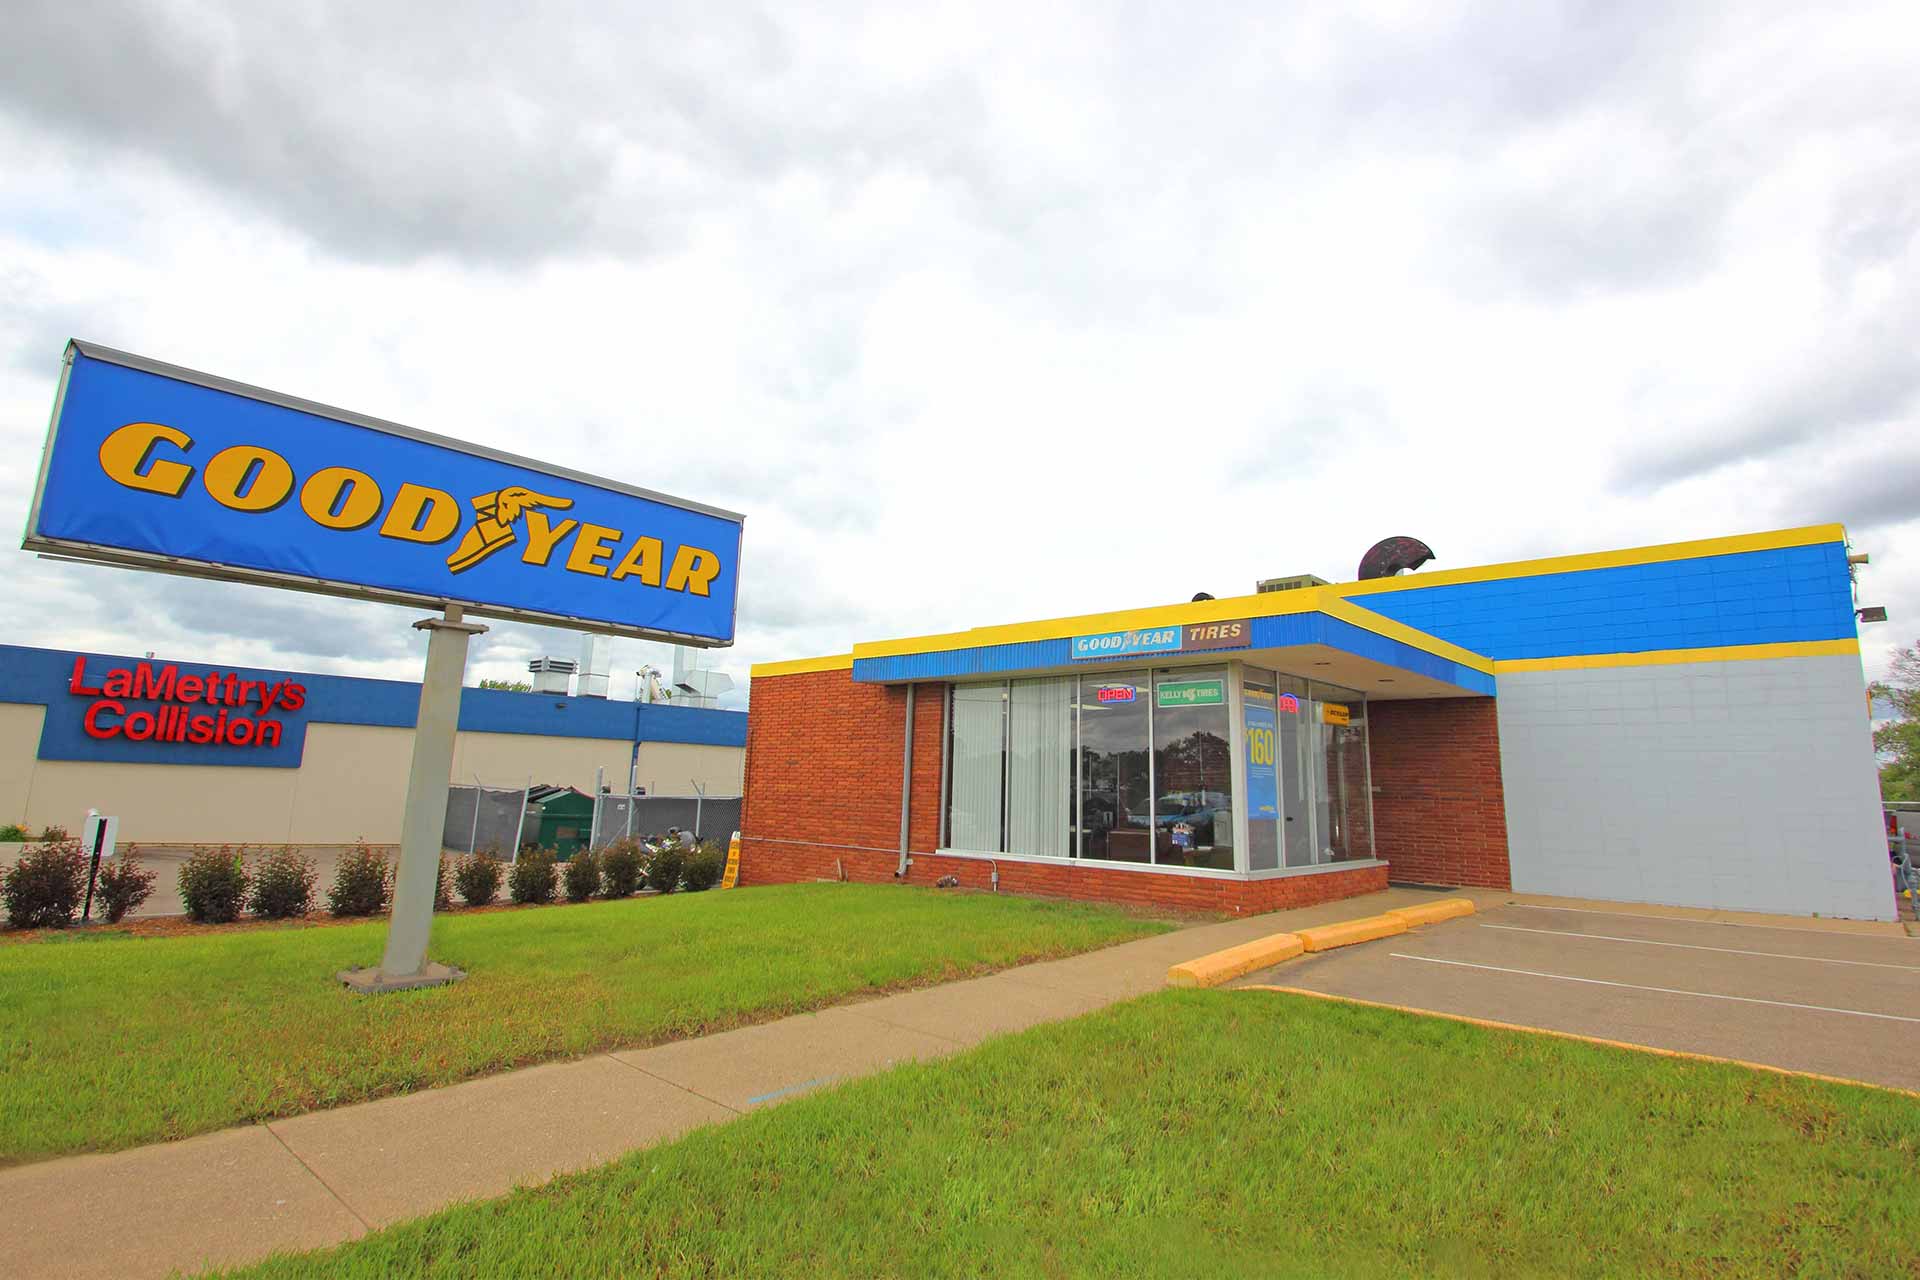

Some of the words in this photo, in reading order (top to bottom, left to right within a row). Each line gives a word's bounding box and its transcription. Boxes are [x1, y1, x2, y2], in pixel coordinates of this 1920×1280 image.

[99, 421, 721, 597] GOODYEAR
[1077, 630, 1175, 652] GOODYEAR
[1190, 623, 1242, 642] TIRES
[69, 655, 307, 717] LaMettry's
[1097, 687, 1133, 701] OPEN
[83, 699, 283, 748] Collision
